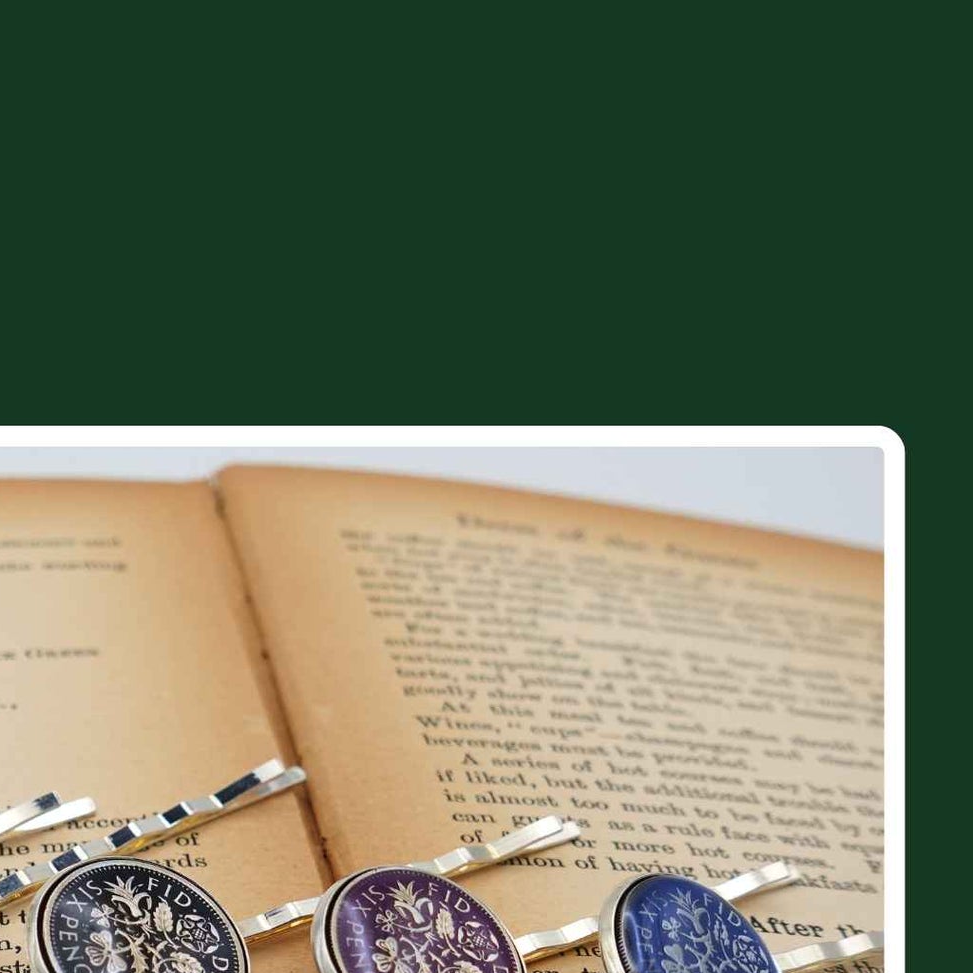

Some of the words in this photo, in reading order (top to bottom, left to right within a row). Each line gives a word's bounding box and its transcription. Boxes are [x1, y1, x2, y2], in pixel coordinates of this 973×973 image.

[461, 753, 479, 766] A
[492, 757, 561, 770] series
[571, 760, 593, 775] of
[436, 770, 454, 783] if
[466, 770, 537, 790] liked,
[544, 775, 588, 790] but
[595, 778, 636, 793] the
[444, 789, 465, 803] is
[475, 791, 559, 808] almost
[571, 797, 609, 811] too
[620, 801, 687, 817] much
[451, 812, 496, 824] can
[176, 833, 201, 846] of
[460, 831, 484, 844] of
[612, 839, 676, 854] more
[685, 842, 731, 859] hot
[574, 853, 597, 869] of
[608, 856, 694, 880] having
[749, 915, 824, 938] After
